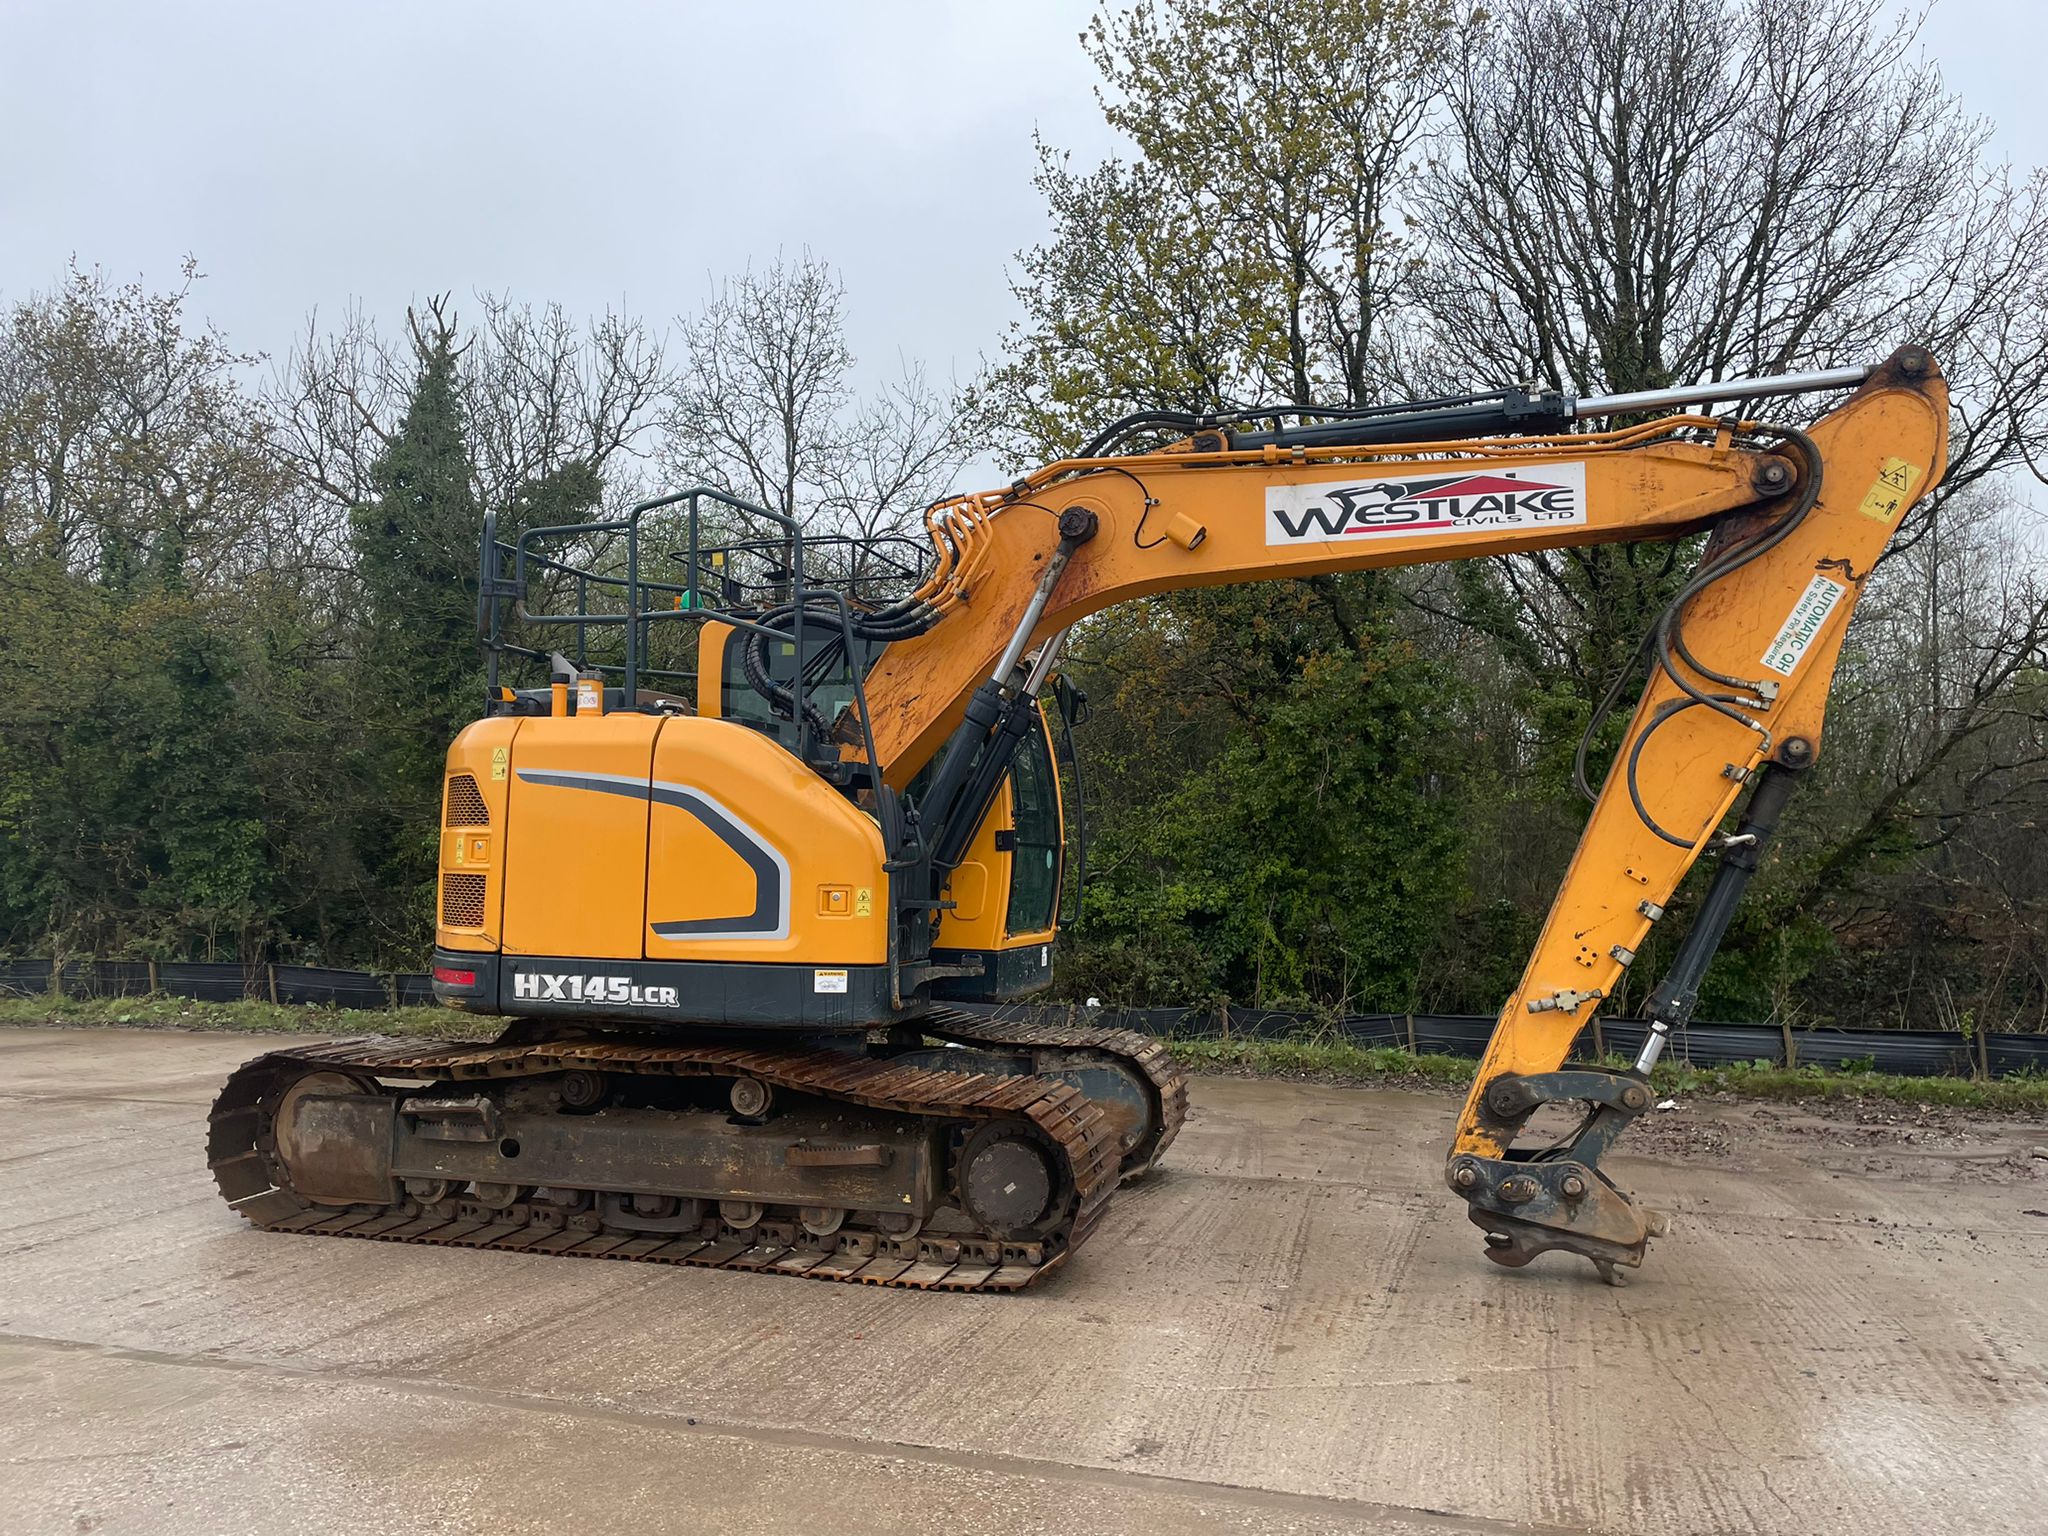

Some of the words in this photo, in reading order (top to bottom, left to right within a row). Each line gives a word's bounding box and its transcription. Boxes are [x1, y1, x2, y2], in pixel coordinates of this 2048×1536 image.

[1273, 488, 1574, 537] WESTLAKE
[1452, 514, 1522, 526] CIVILS
[1534, 511, 1574, 521] LTD
[1814, 577, 1827, 589] No
[1790, 582, 1839, 651] AUTOMATIC
[1795, 590, 1818, 617] Safety
[1787, 617, 1801, 630] Pin
[1765, 631, 1792, 666] Required
[1776, 652, 1795, 673] QH
[514, 973, 680, 1007] HX145LCR
